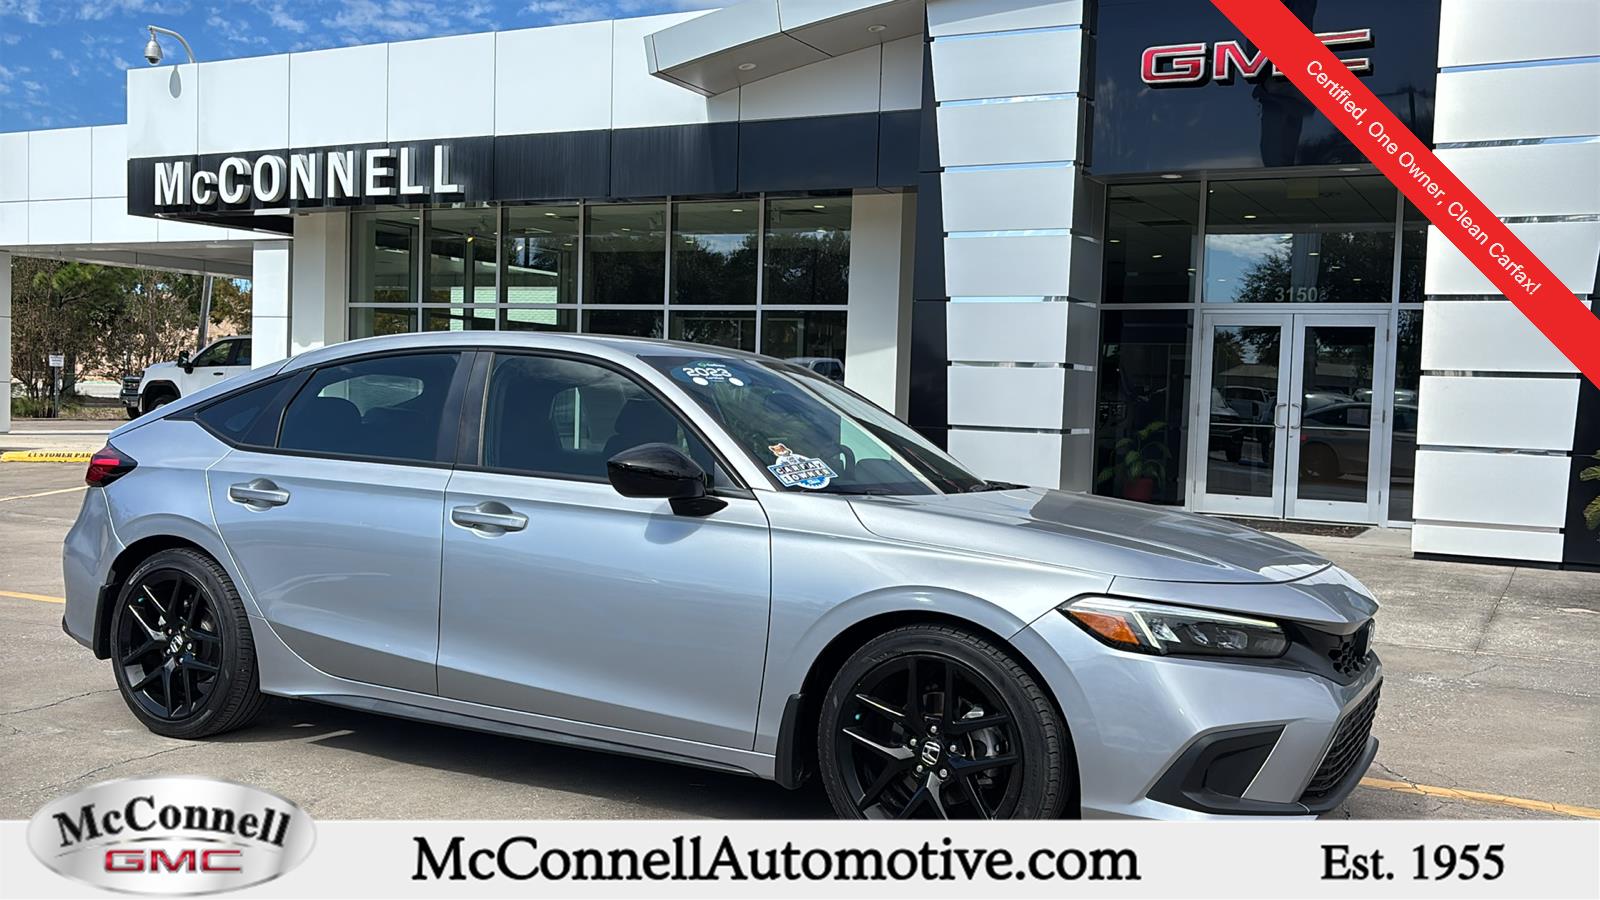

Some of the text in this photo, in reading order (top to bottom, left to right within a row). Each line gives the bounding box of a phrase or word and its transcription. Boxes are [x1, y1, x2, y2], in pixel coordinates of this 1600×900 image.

[154, 145, 464, 205] McCONNELL
[1274, 286, 1318, 302] 3150
[682, 367, 732, 377] 2023
[775, 460, 824, 475] CARFAX
[791, 469, 831, 481] OWNER
